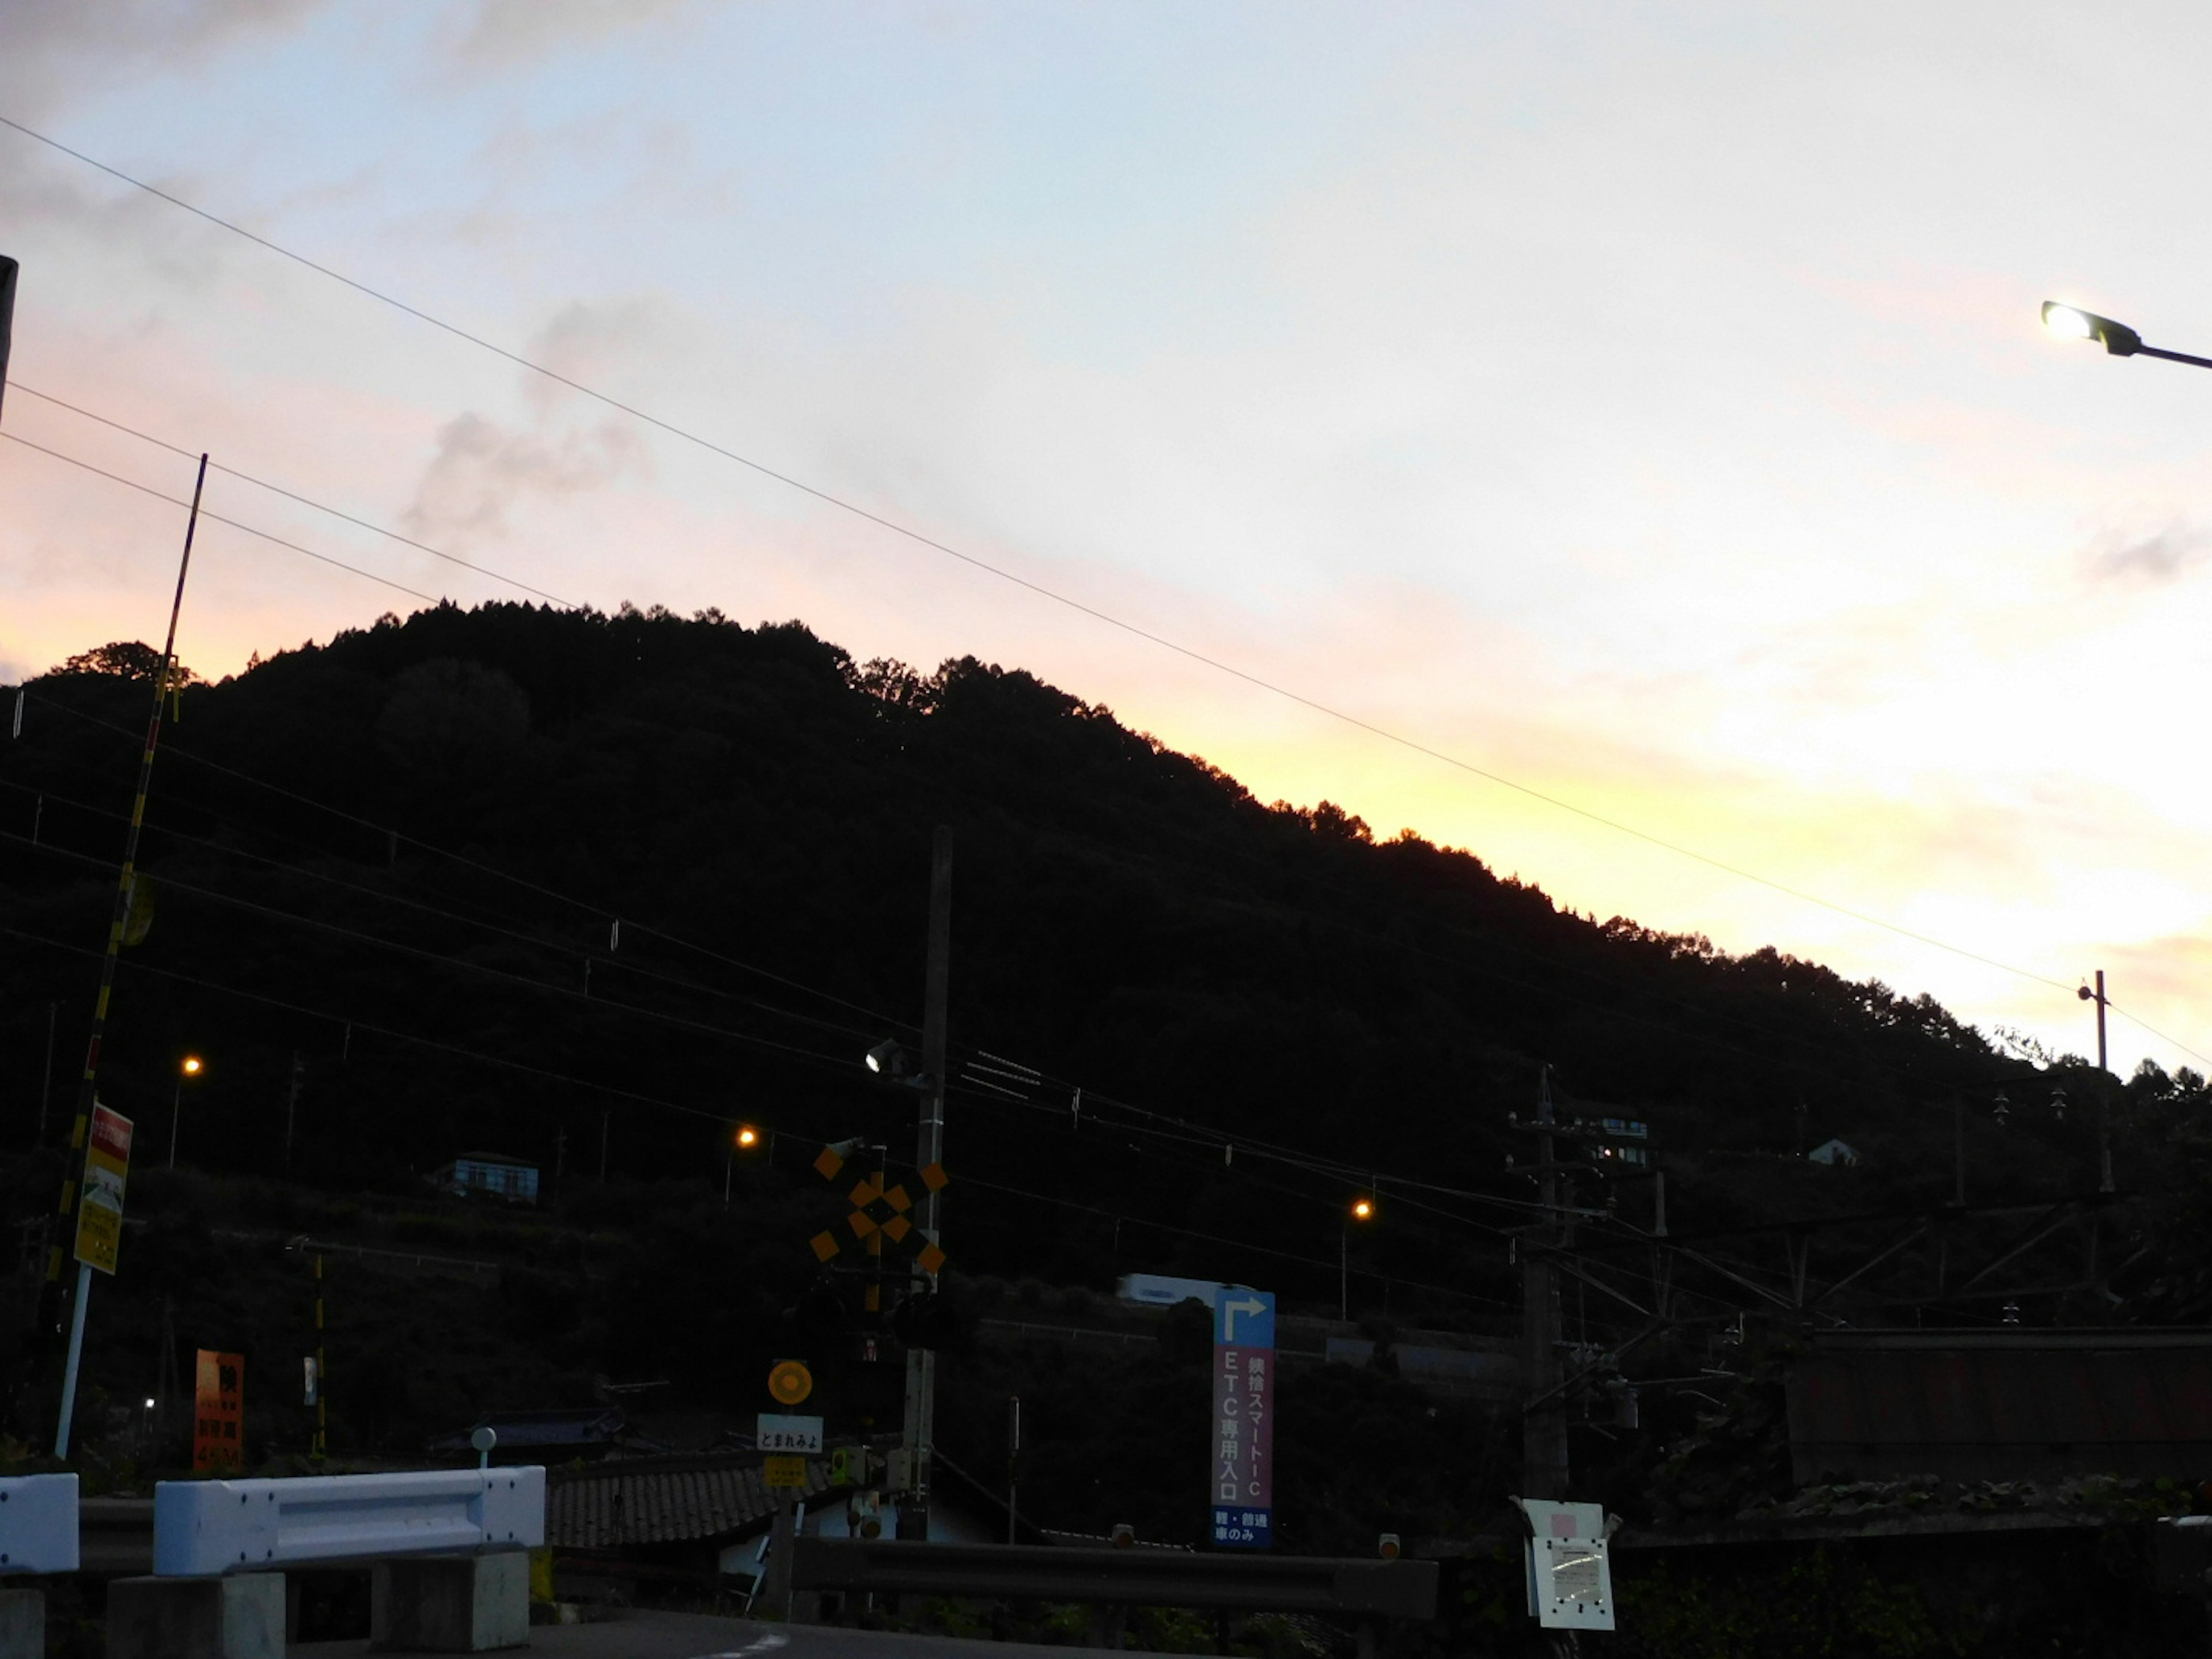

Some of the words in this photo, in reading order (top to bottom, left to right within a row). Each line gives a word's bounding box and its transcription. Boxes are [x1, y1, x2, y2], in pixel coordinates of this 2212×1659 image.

[1220, 1351, 1238, 1501] ETC専用入口
[762, 1433, 816, 1449] とまれみよ
[1215, 1526, 1255, 1542] 車のみ
